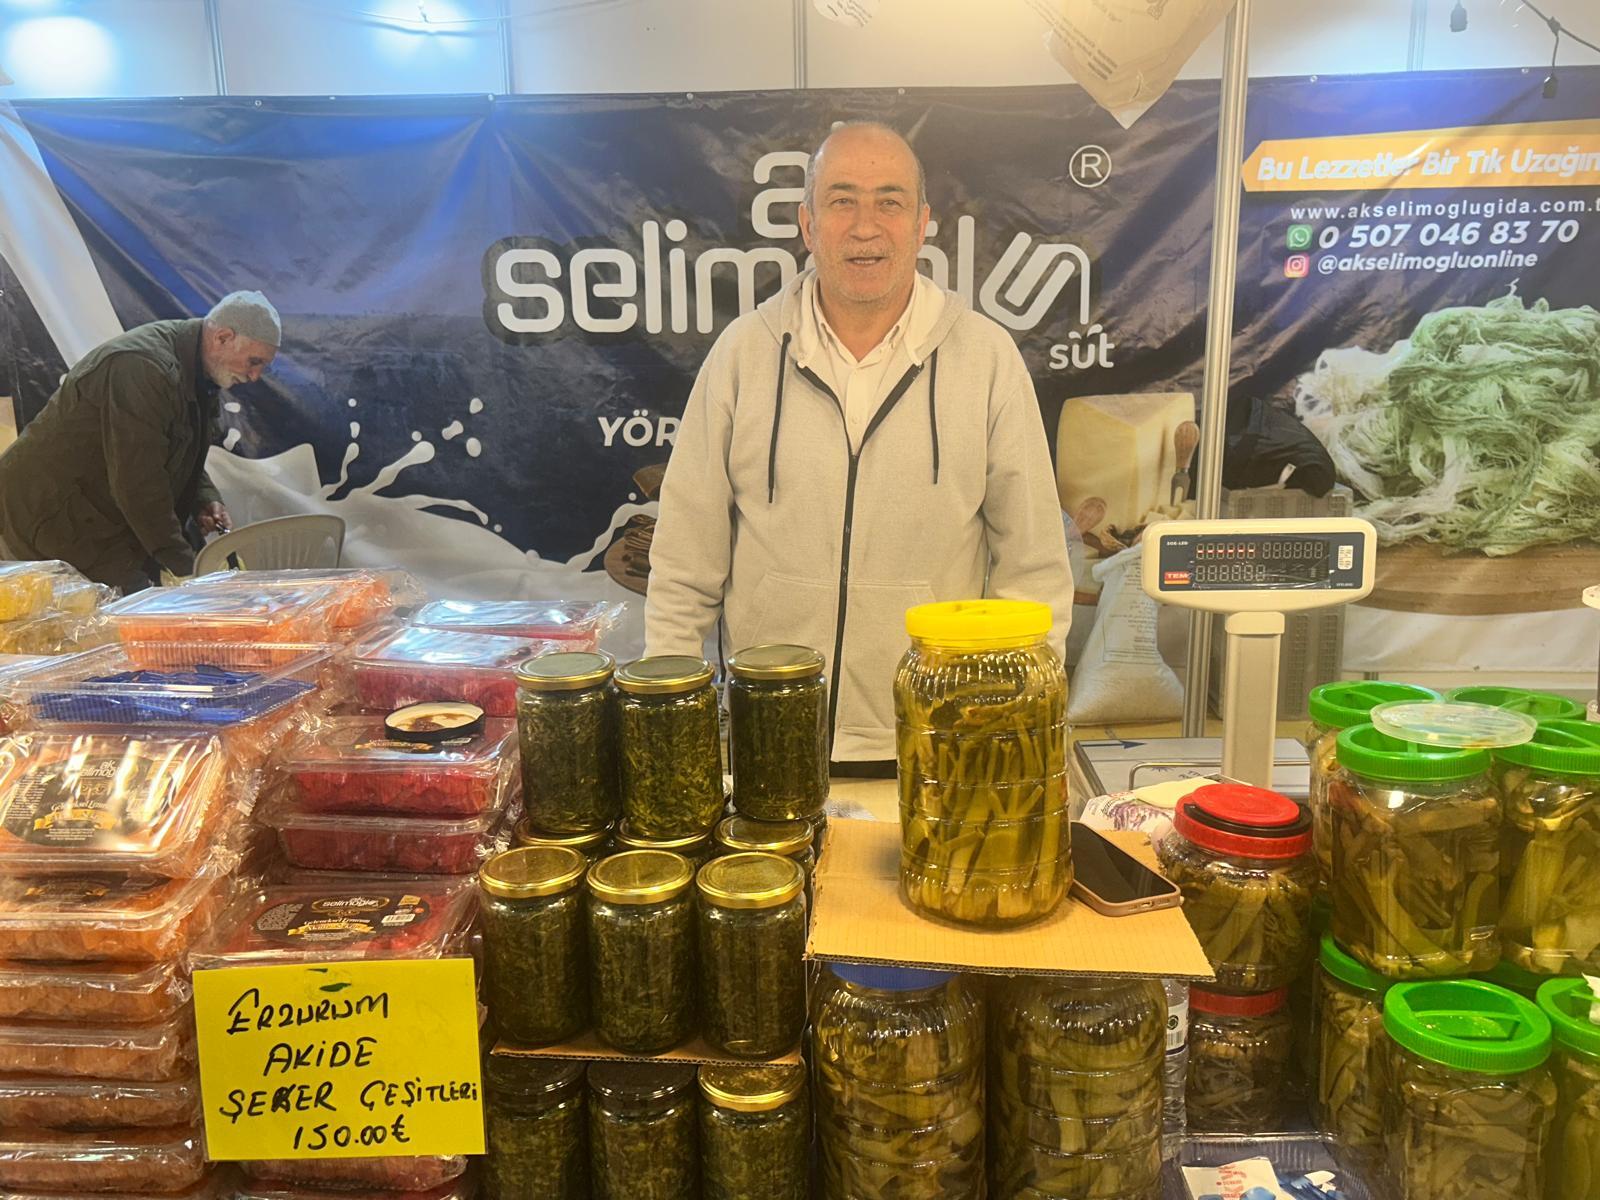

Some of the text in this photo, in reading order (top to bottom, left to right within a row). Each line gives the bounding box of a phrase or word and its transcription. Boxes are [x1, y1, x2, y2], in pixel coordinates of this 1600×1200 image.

[1257, 156, 1294, 181] Bu
[1421, 148, 1461, 176] Bir
[1318, 219, 1580, 249] 0 507 046 83 70
[1317, 249, 1538, 275] @akselimogluonline
[1049, 323, 1115, 370] süt
[226, 987, 389, 1036] ERZURUM
